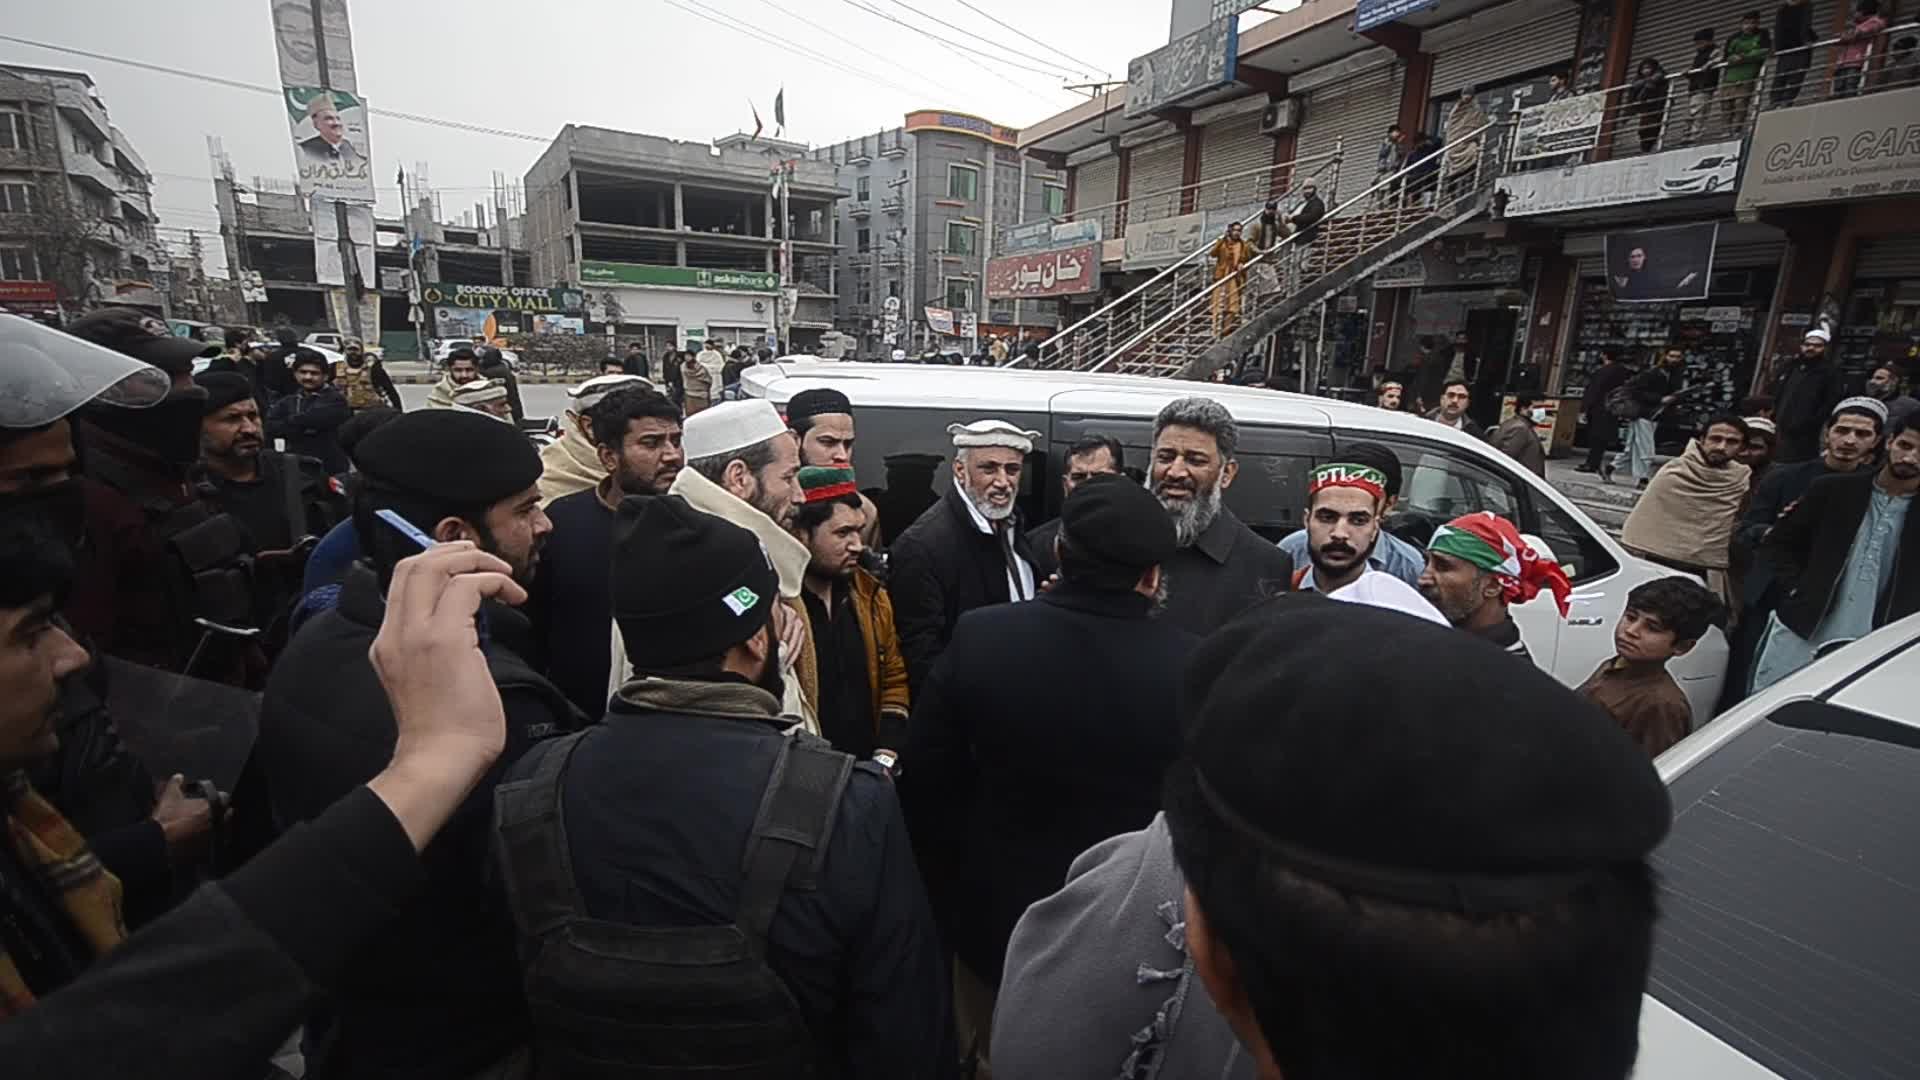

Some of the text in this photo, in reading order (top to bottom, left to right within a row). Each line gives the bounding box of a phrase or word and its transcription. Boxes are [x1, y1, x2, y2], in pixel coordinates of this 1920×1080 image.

[1765, 136, 1839, 172] CAR
[456, 284, 549, 298] BOOKING OFFICE
[454, 294, 503, 308] CITY
[506, 296, 558, 311] MALL
[1317, 467, 1345, 488] PTI
